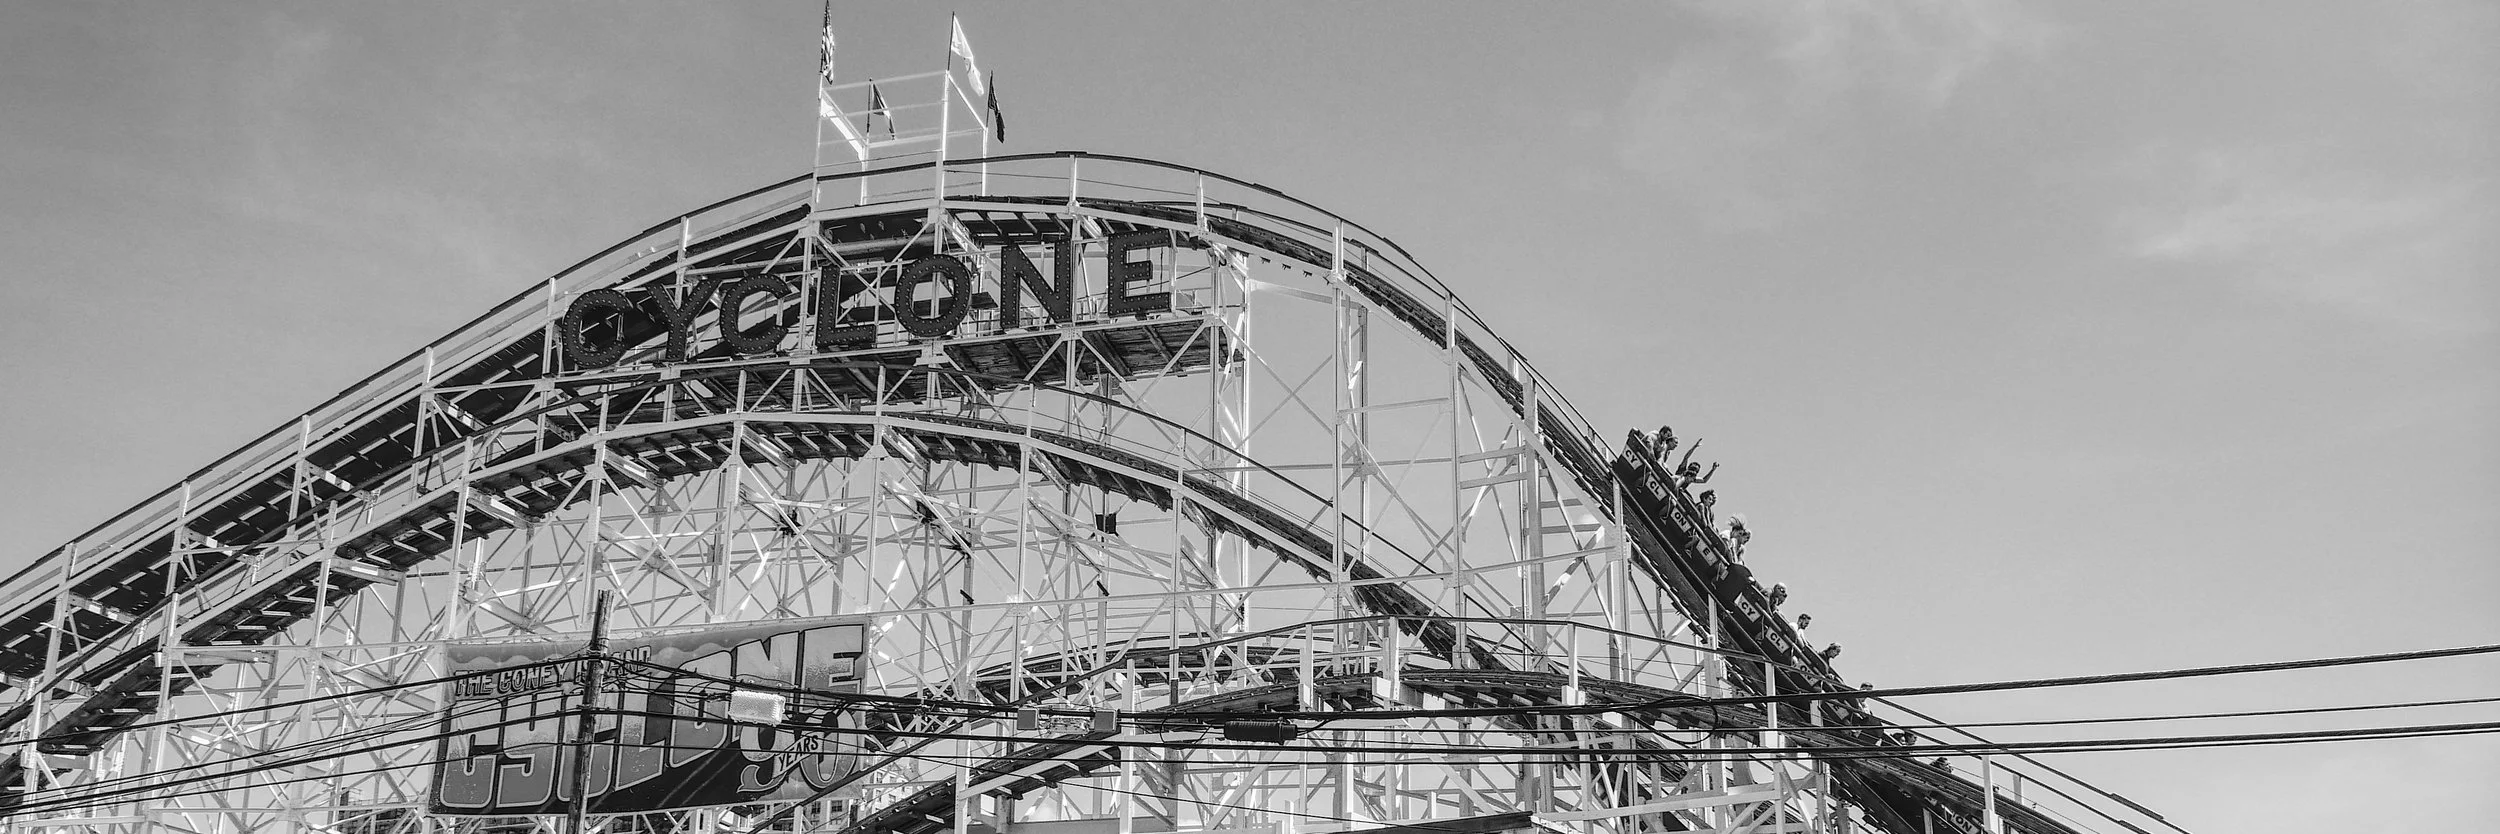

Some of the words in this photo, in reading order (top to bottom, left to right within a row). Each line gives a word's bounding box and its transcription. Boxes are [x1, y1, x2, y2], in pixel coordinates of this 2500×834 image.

[562, 228, 1172, 370] CYCLONE
[1625, 449, 1638, 464] CY
[1649, 481, 1661, 495] CL
[1674, 511, 1687, 526] ON
[1741, 602, 1756, 616] CY
[454, 670, 494, 697] THE
[498, 662, 569, 692] CONEY
[778, 735, 819, 771] YEARS
[1955, 816, 1972, 832] ON
